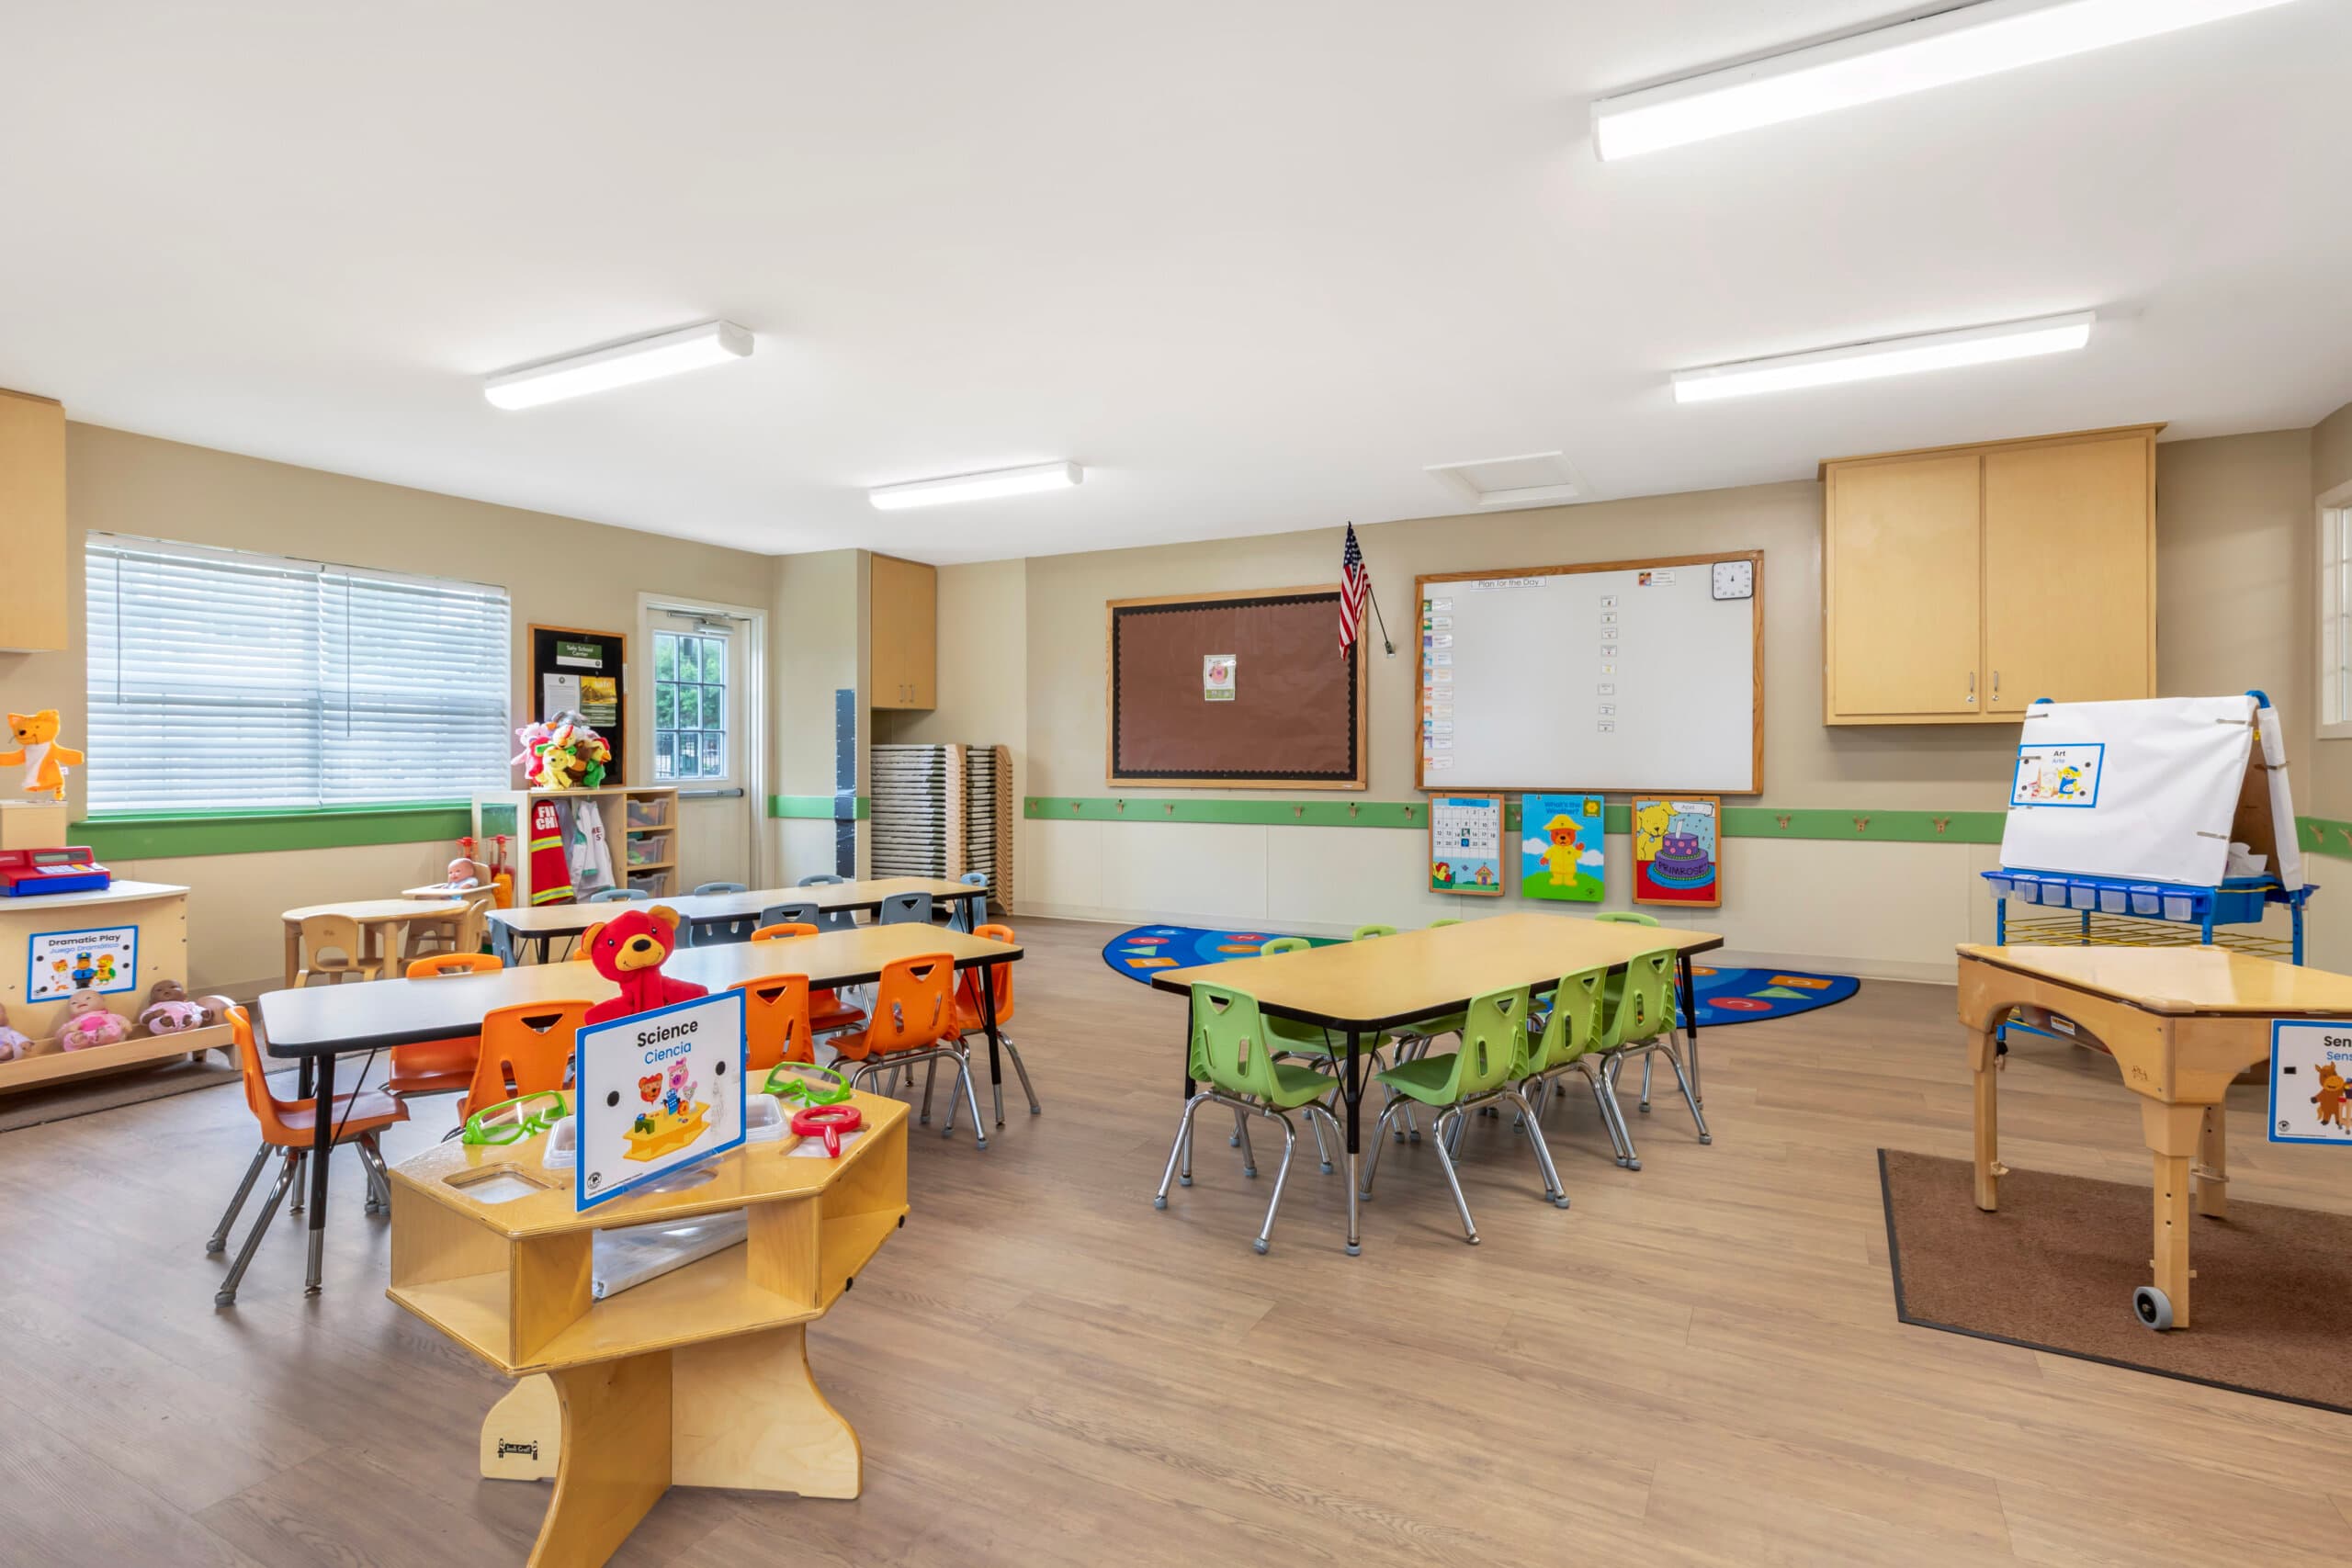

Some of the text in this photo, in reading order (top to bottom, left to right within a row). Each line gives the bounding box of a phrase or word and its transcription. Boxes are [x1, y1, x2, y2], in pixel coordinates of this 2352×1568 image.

[1509, 579, 1521, 587] the
[49, 934, 120, 946] Dramatic Play
[637, 1020, 699, 1048] Science
[644, 1040, 692, 1065] Ciencia
